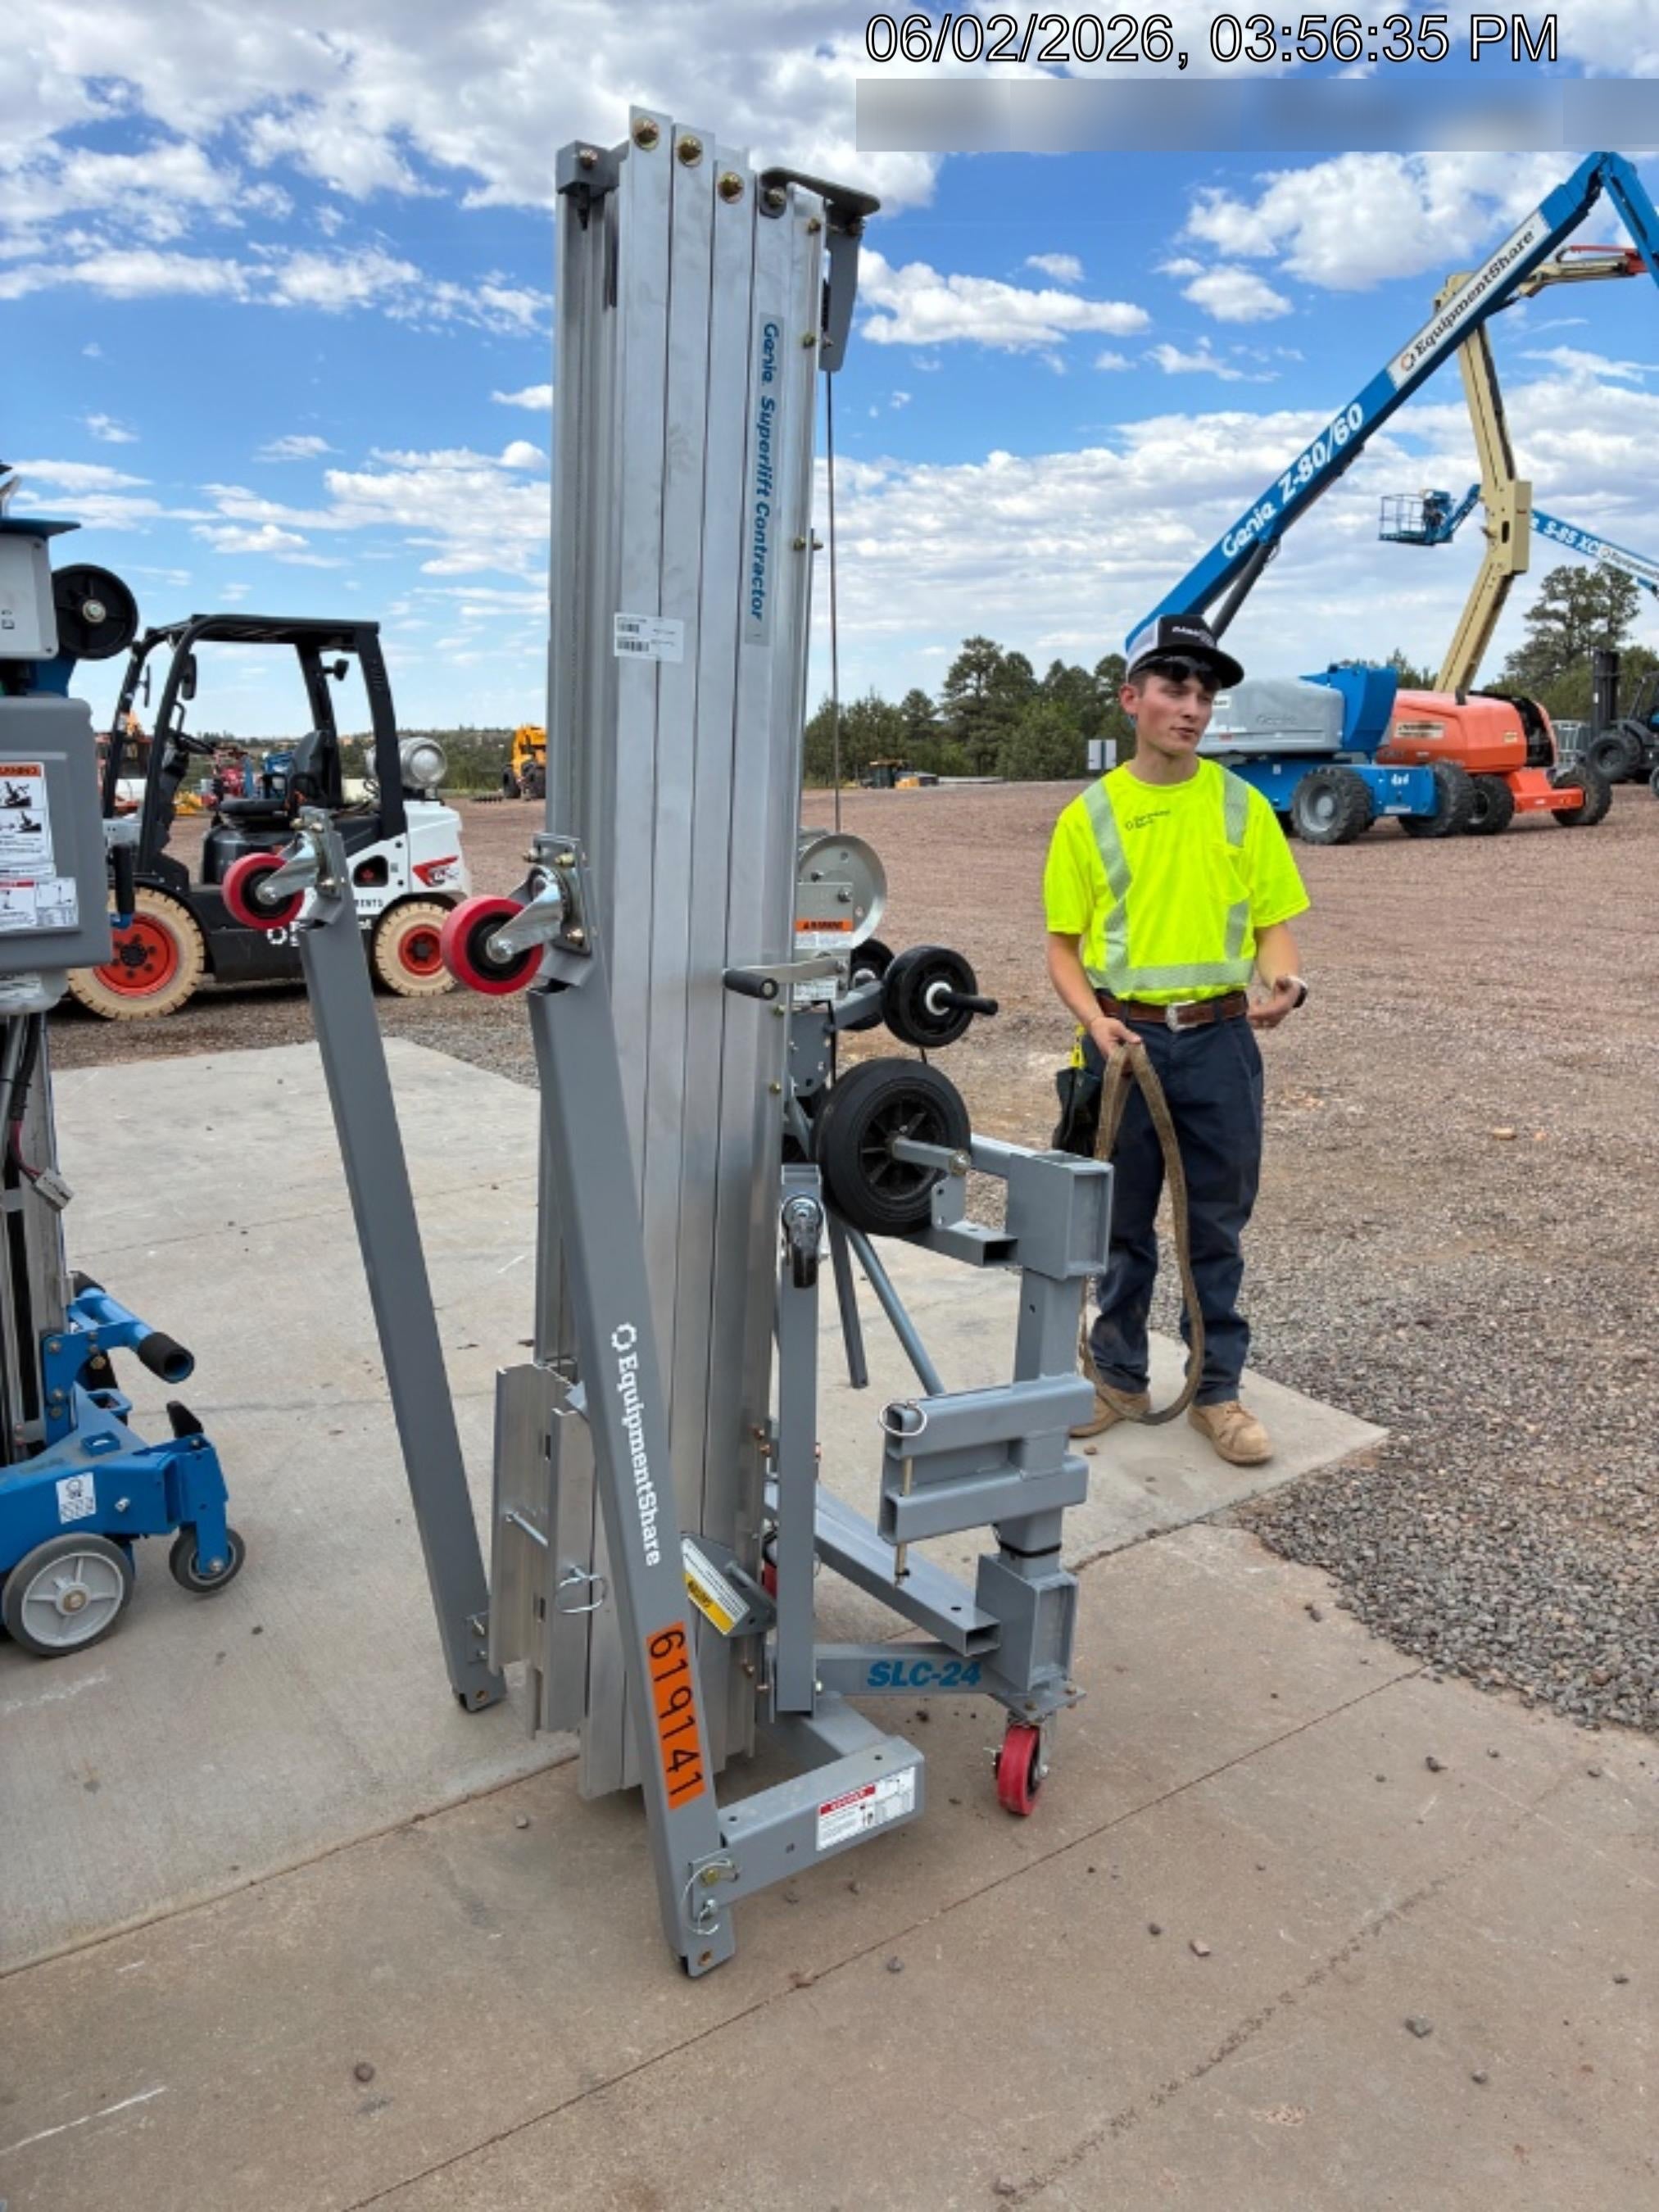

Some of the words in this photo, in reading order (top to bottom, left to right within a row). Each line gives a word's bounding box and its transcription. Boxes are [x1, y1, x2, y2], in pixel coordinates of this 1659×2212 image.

[761, 322, 780, 383] Genie
[1414, 230, 1535, 356] EquipmentShare
[755, 397, 775, 496] Superlift
[1222, 502, 1277, 558] Genie
[1278, 402, 1363, 505] Z-80/60
[750, 501, 770, 621] Contractor
[617, 1352, 660, 1566] EquipmentShare
[650, 1630, 702, 1796] 619141
[867, 1661, 981, 1686] SLC-24
